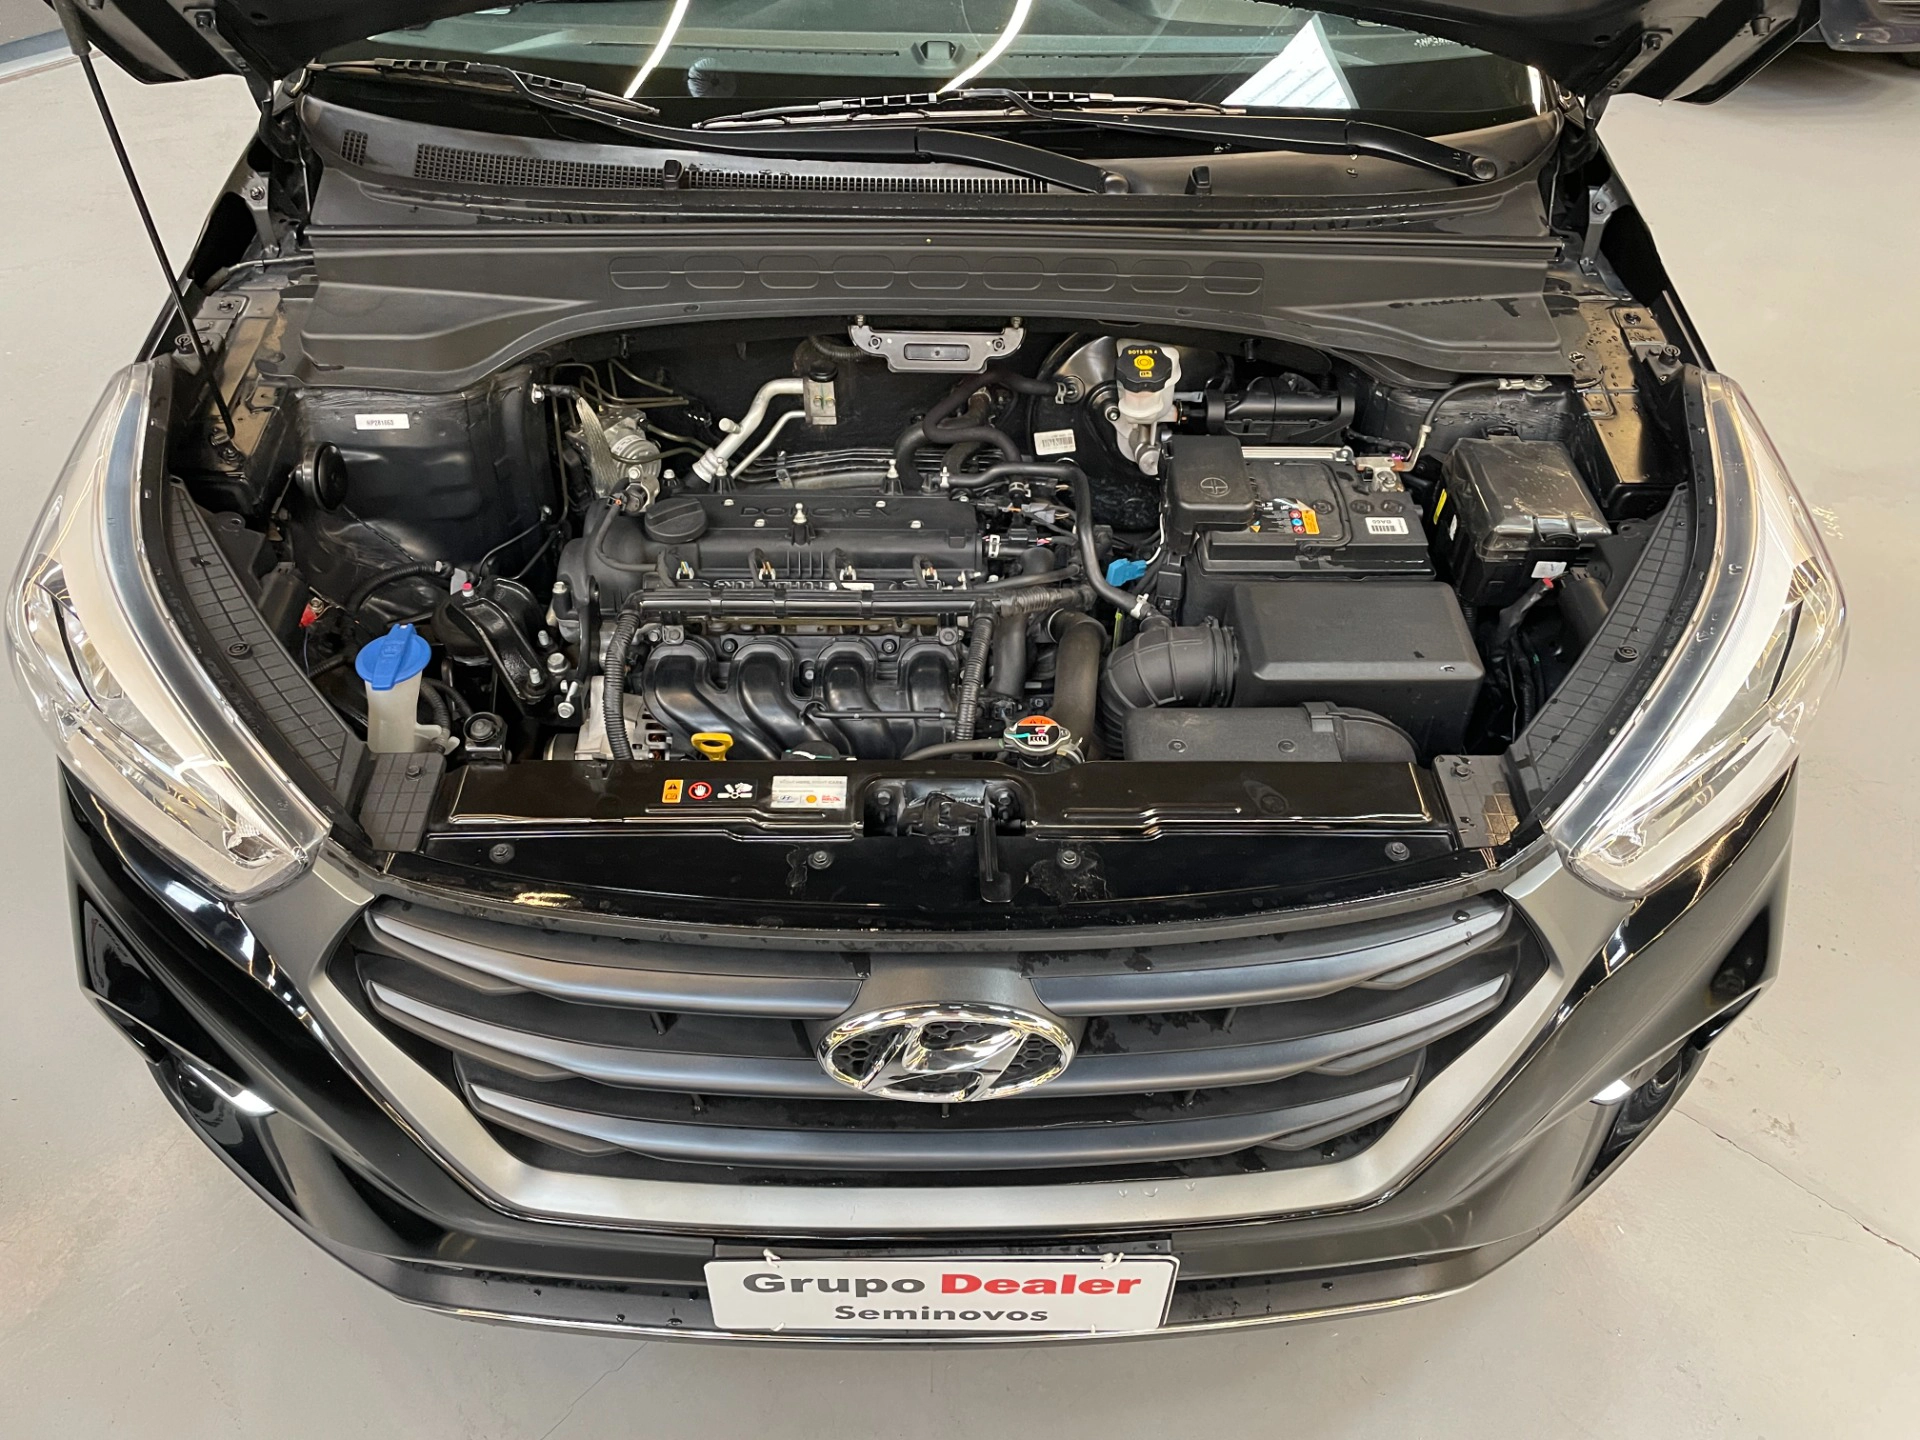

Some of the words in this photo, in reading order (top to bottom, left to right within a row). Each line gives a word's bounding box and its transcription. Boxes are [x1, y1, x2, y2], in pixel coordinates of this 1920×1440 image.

[743, 1273, 926, 1297] Grupo
[941, 1273, 1141, 1295] Dealer
[834, 1305, 1049, 1322] Seminovos
